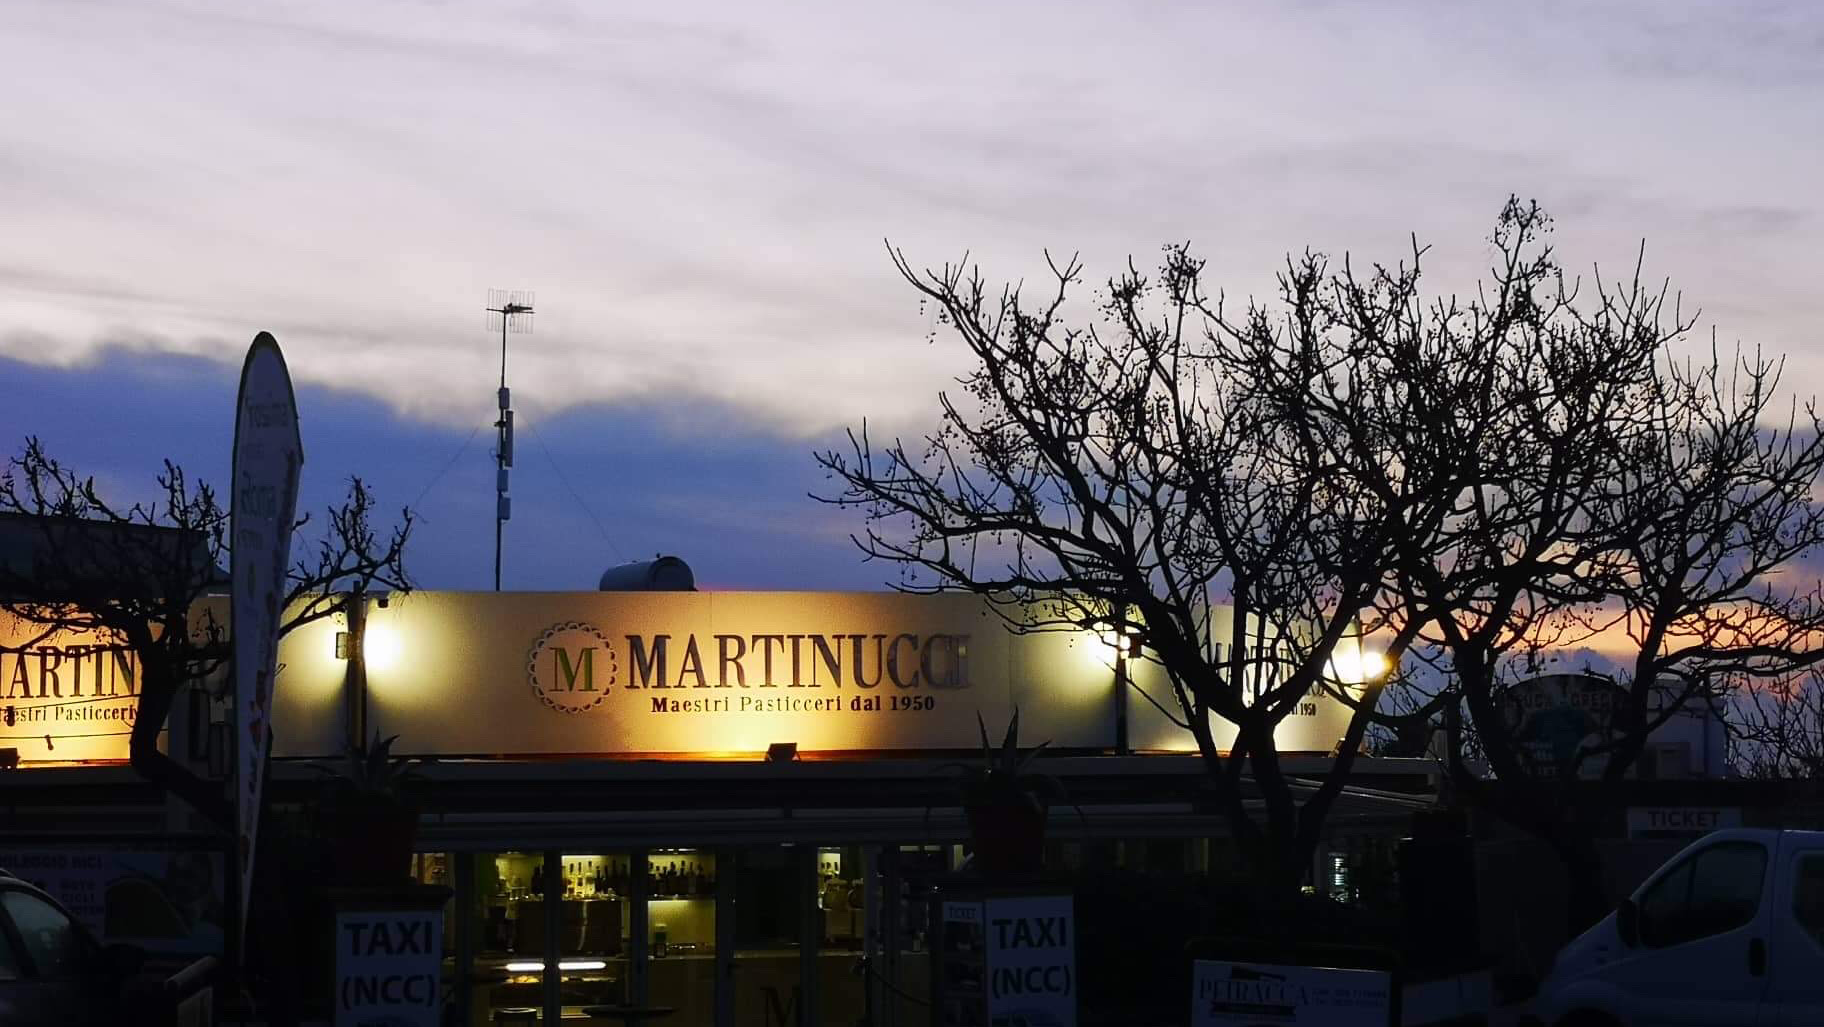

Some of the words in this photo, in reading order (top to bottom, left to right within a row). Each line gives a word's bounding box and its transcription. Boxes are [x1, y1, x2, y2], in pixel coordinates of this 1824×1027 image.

[0, 645, 136, 698] ARTIN
[549, 647, 599, 692] M
[625, 634, 972, 690] MARTINUCCI
[651, 696, 729, 713] Maestri
[740, 696, 841, 712] Pasticceri
[850, 696, 881, 711] dal
[890, 696, 935, 711] 1950
[1648, 811, 1721, 828] TICKET
[344, 921, 433, 955] TAXI
[992, 917, 1067, 949] TAXI
[342, 975, 435, 1009] (NCC)
[992, 964, 1071, 1000] (NCC)
